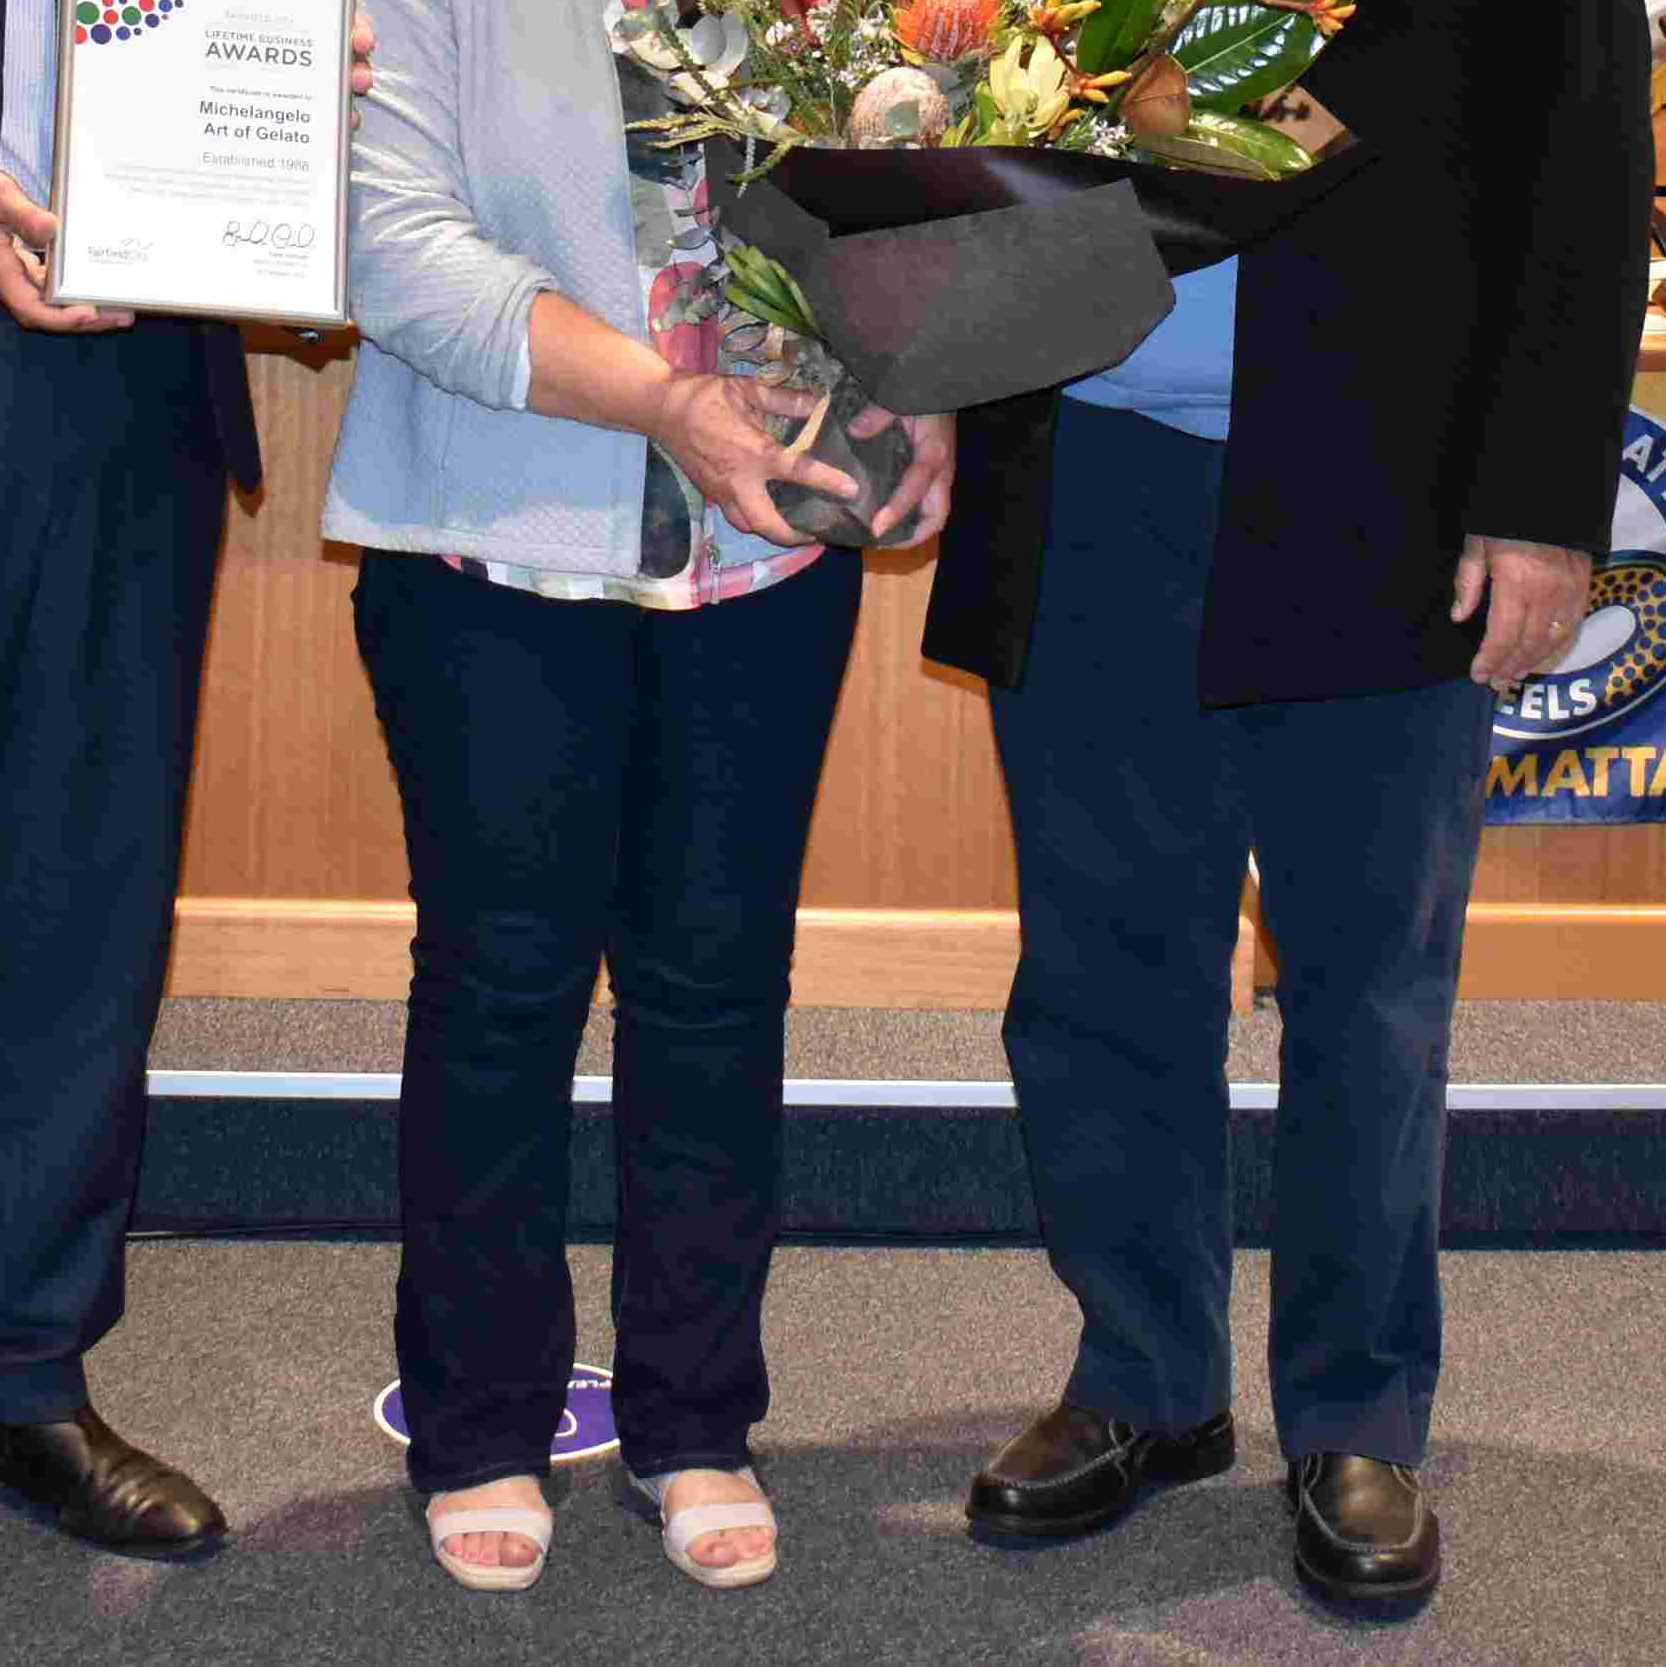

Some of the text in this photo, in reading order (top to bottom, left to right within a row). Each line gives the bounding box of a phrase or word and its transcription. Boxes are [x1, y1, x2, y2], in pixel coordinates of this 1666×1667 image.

[205, 41, 313, 67] AWARDS
[199, 100, 311, 124] Michelangelo
[204, 122, 310, 144] Art of Gelato
